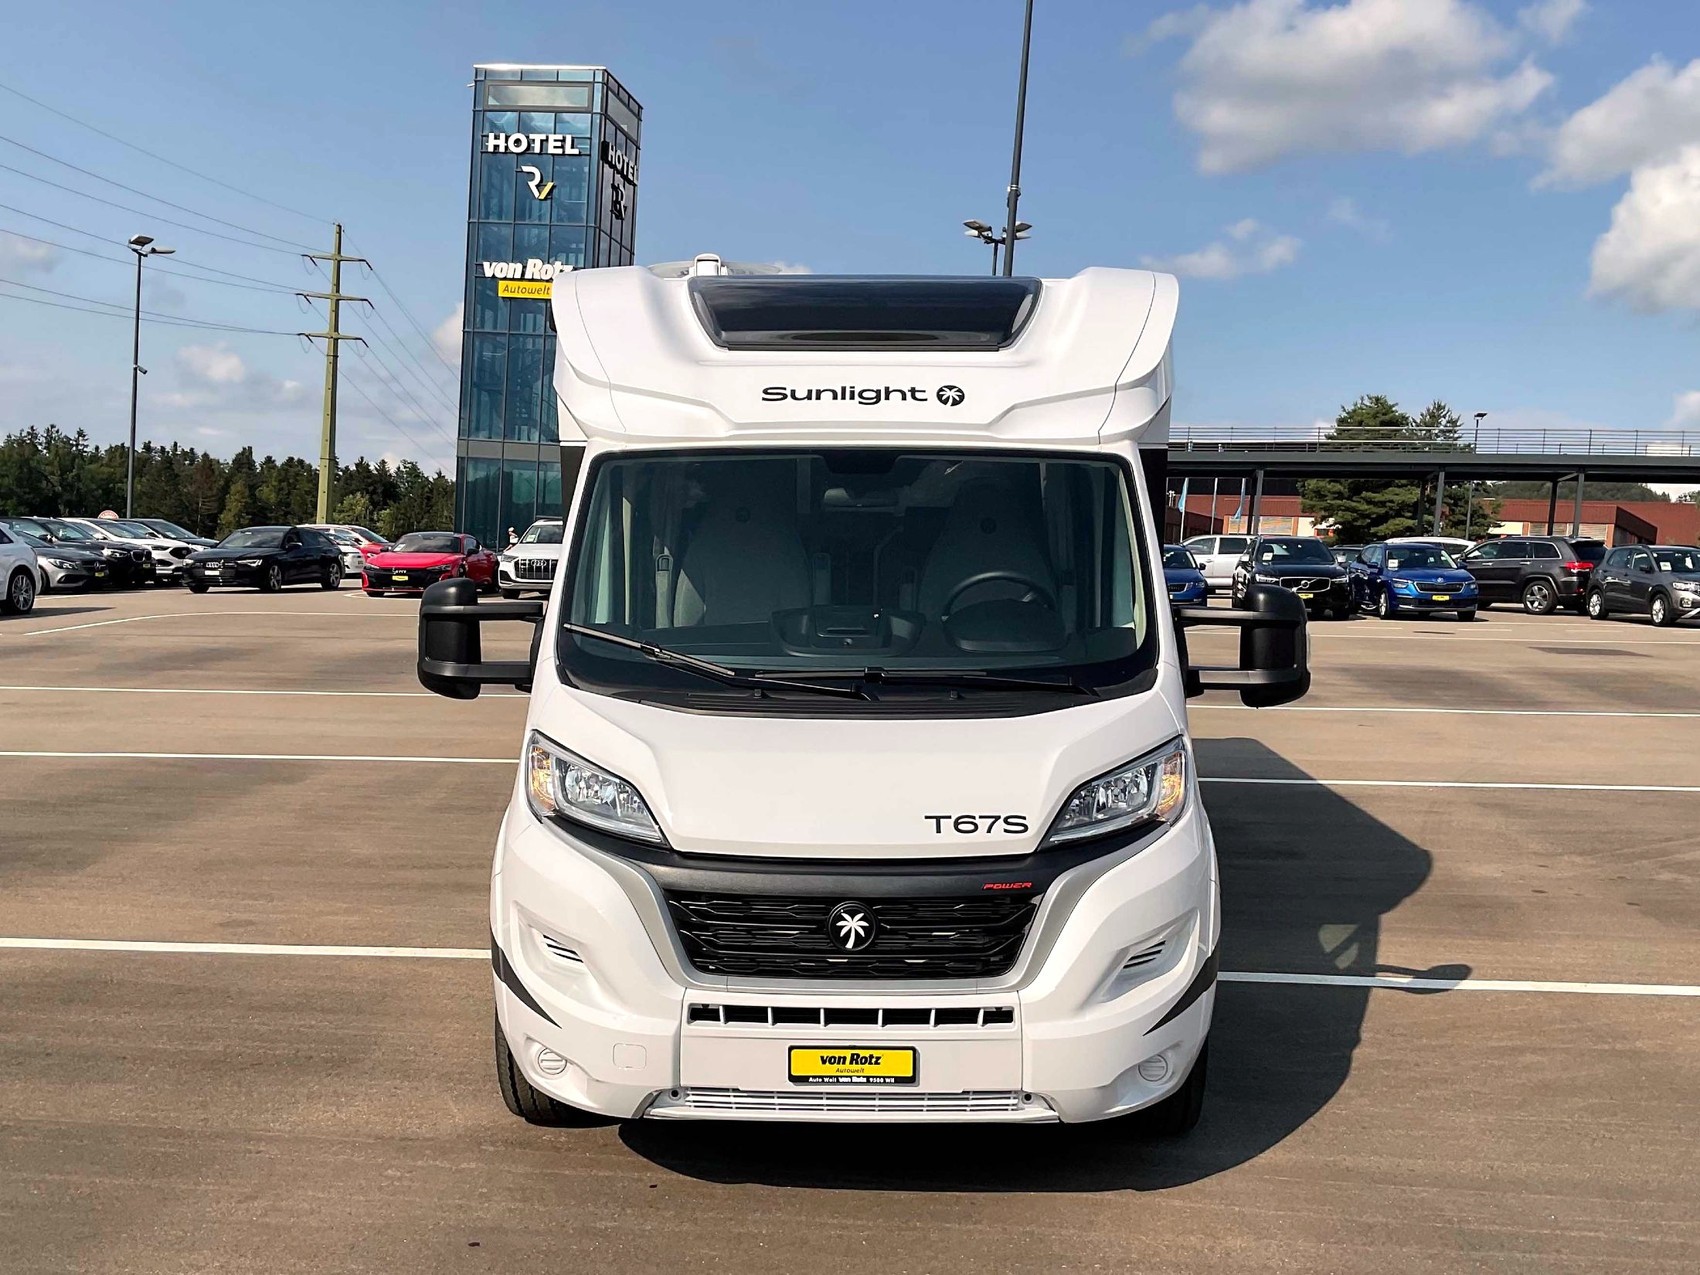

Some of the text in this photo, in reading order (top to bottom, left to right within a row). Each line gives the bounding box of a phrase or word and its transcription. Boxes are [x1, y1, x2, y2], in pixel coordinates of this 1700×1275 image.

[487, 133, 579, 154] HOTEL
[608, 141, 638, 184] HOTEL
[482, 261, 523, 279] von
[502, 284, 551, 296] Autowelt
[761, 385, 928, 406] Sunlight
[924, 815, 1029, 834] T67S
[983, 882, 1032, 890] POWER
[820, 1053, 881, 1065] von Rotz
